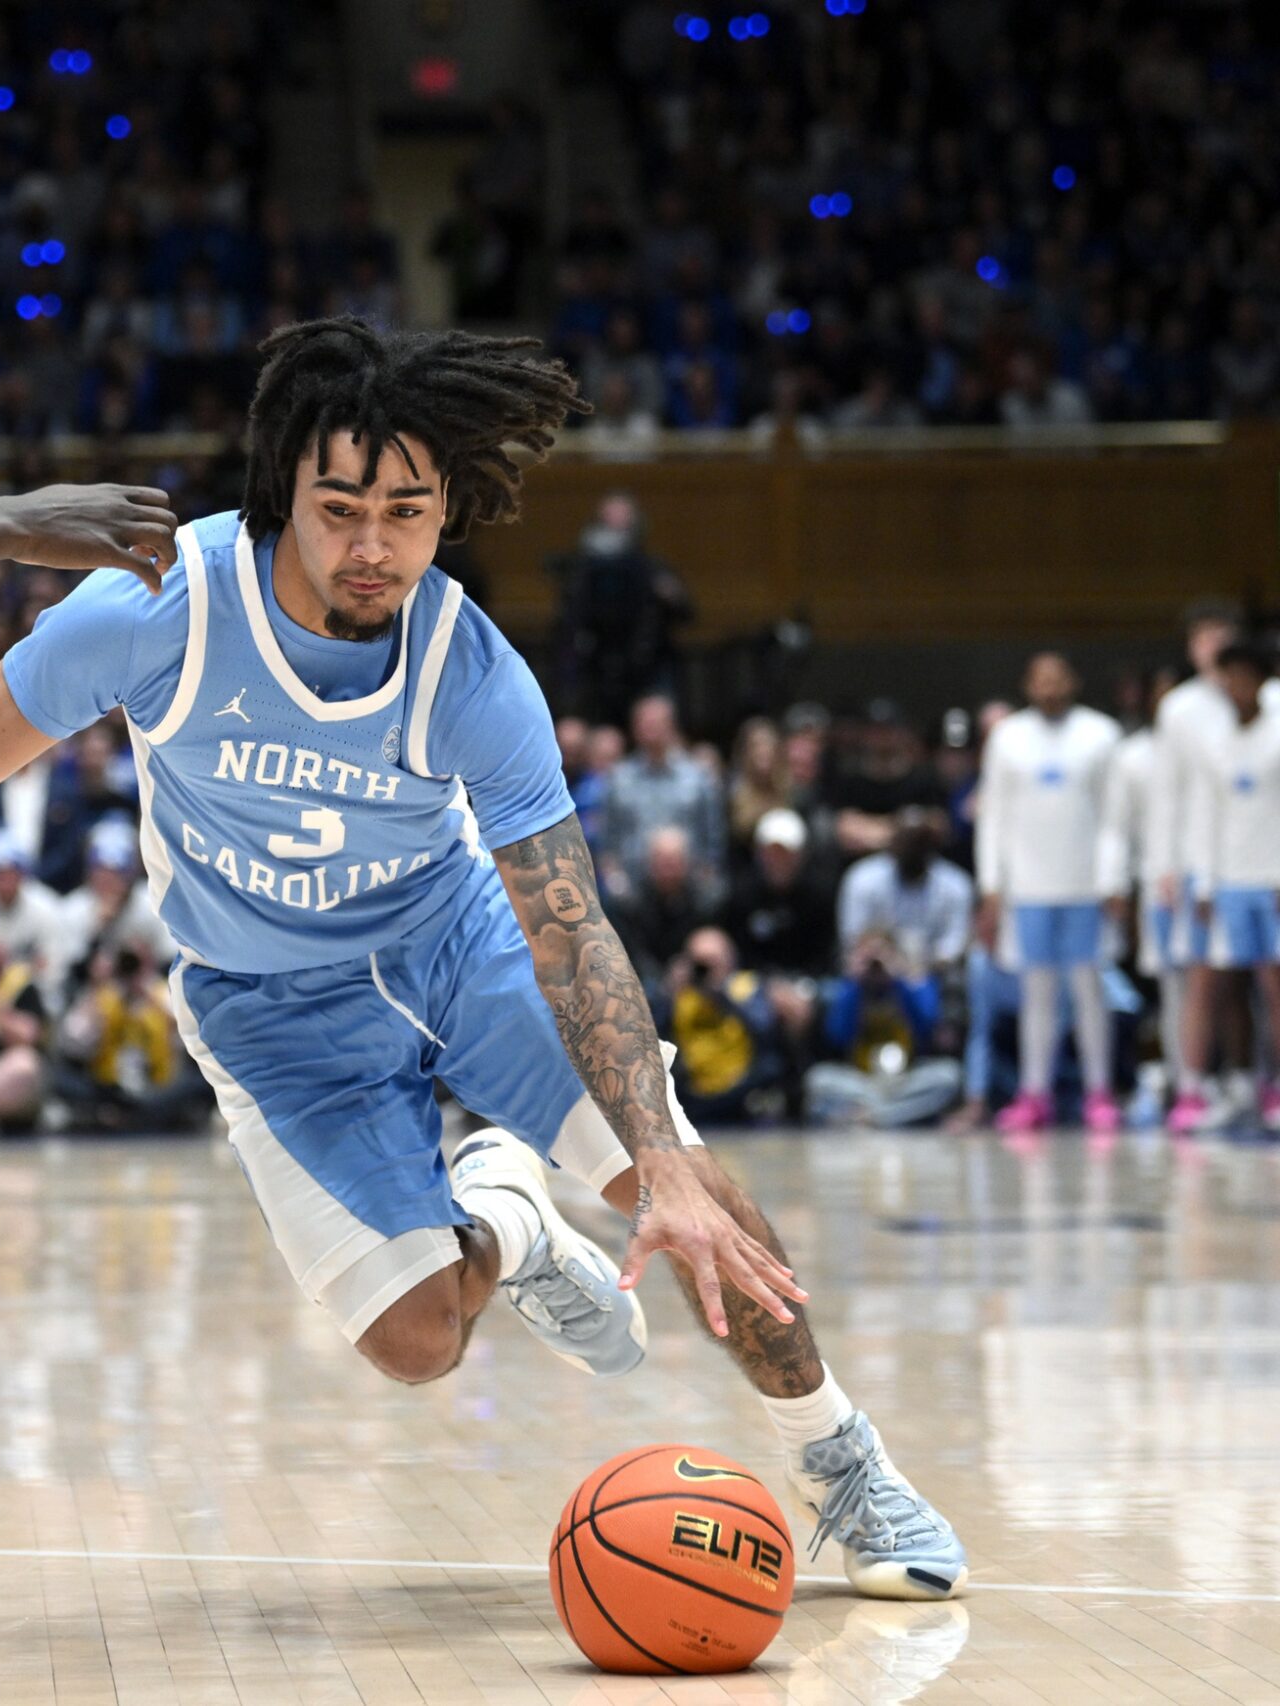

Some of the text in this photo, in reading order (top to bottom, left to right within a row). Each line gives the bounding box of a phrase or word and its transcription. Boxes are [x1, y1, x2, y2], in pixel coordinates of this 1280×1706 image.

[214, 740, 400, 800] NORTH
[267, 796, 346, 859] 3
[182, 823, 431, 912] CAROLINA
[669, 1547, 778, 1592] CHONSHIP
[672, 1511, 782, 1581] ELITE
